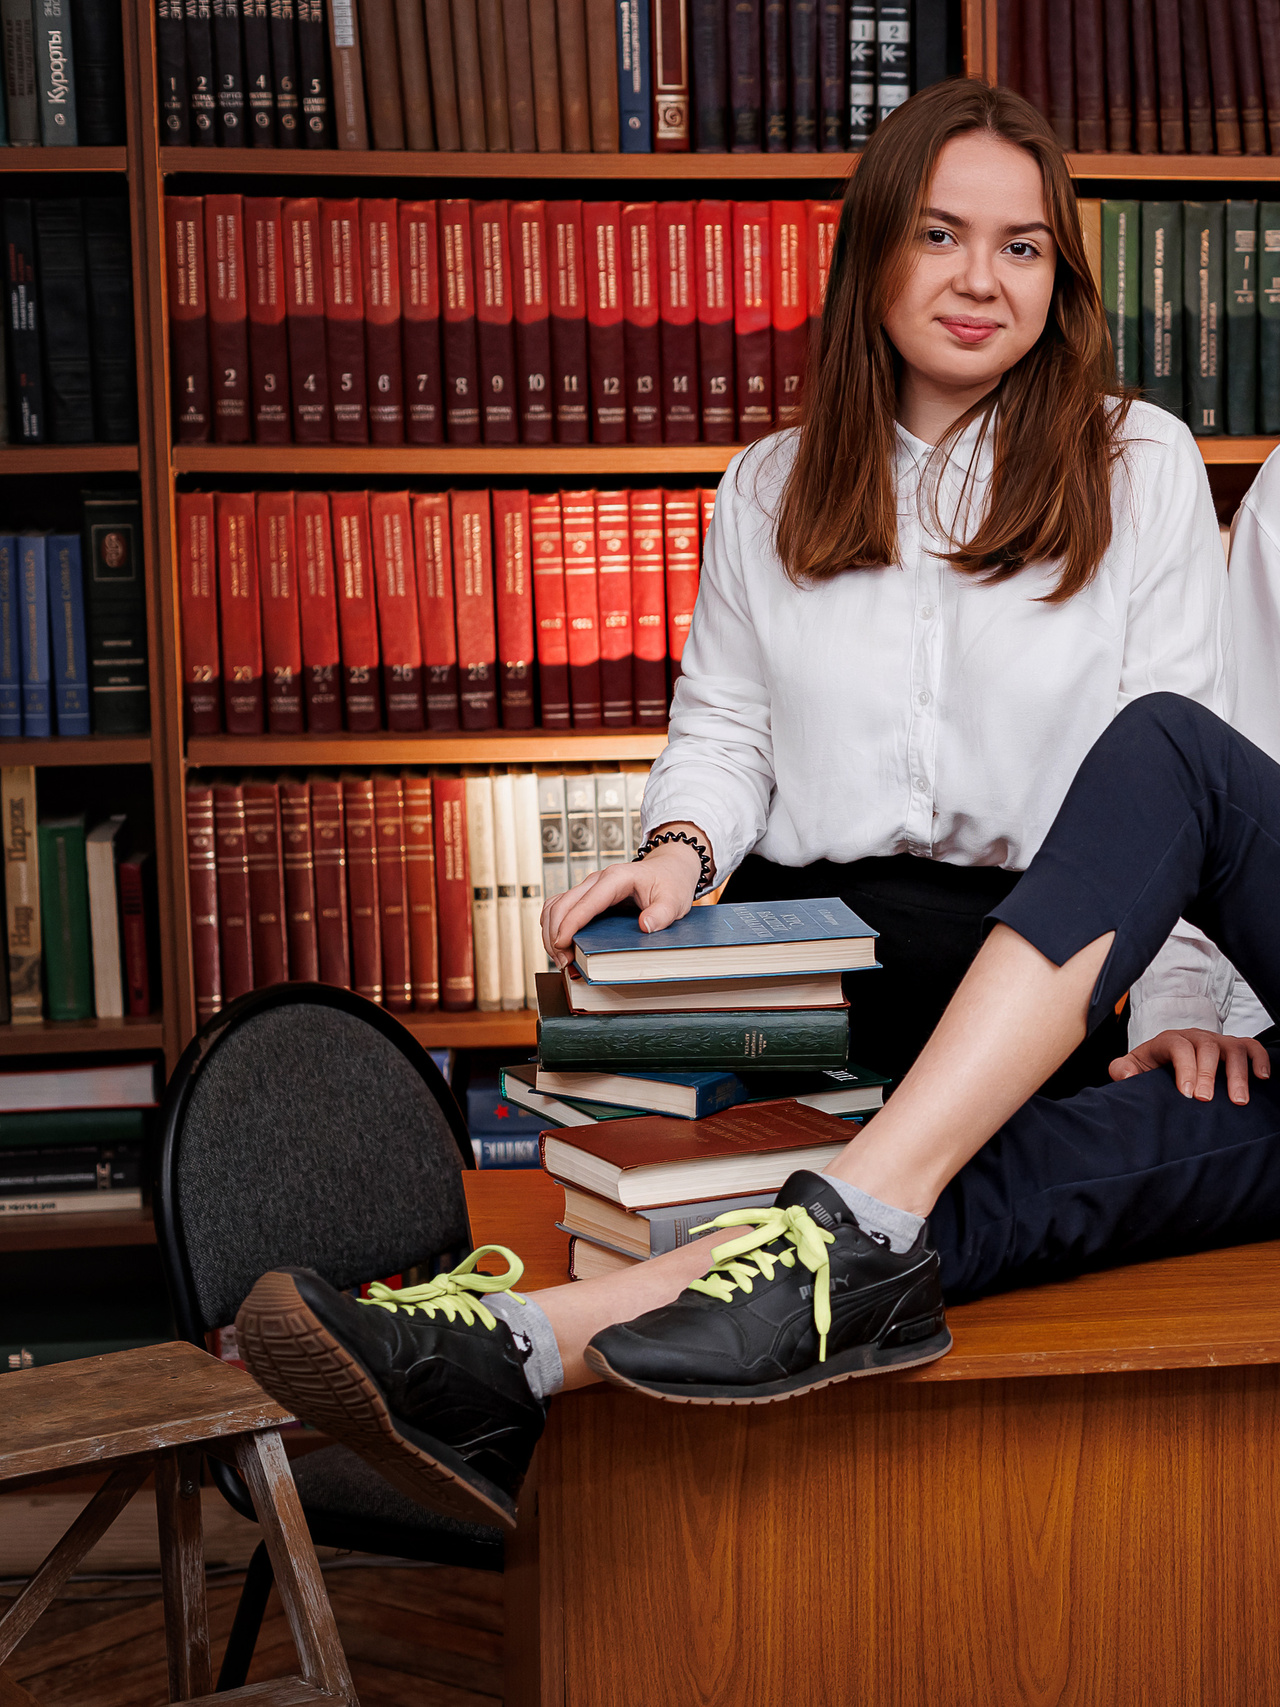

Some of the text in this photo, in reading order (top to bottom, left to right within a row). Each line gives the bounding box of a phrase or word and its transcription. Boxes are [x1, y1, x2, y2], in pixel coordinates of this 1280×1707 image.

[889, 25, 899, 39] 2
[47, 31, 69, 104] Курорты
[170, 77, 176, 91] 1
[197, 75, 207, 91] 2
[223, 74, 234, 89] 3
[256, 74, 266, 89] 4
[281, 76, 292, 91] 6
[311, 78, 321, 94] 5
[186, 375, 195, 393] 1
[224, 368, 236, 387] 2
[264, 373, 276, 392] 3
[304, 374, 316, 392] 4
[341, 373, 352, 391] 5
[378, 374, 390, 392] 6
[417, 374, 428, 392] 7
[456, 377, 468, 395] 8
[492, 375, 504, 392] 9
[528, 373, 545, 392] 10
[564, 374, 579, 392] 11
[603, 377, 620, 394] 12
[637, 375, 653, 392] 13
[673, 375, 688, 392] 14
[710, 376, 727, 394] 15
[748, 375, 765, 393] 16
[784, 375, 800, 393] 17
[193, 665, 213, 683] 22
[233, 666, 253, 684] 23
[274, 666, 293, 684] 24
[312, 665, 333, 683] 24
[350, 666, 369, 684] 25
[392, 664, 413, 682] 26
[431, 665, 449, 683] 27
[468, 661, 488, 681] 28
[506, 661, 527, 680] 29
